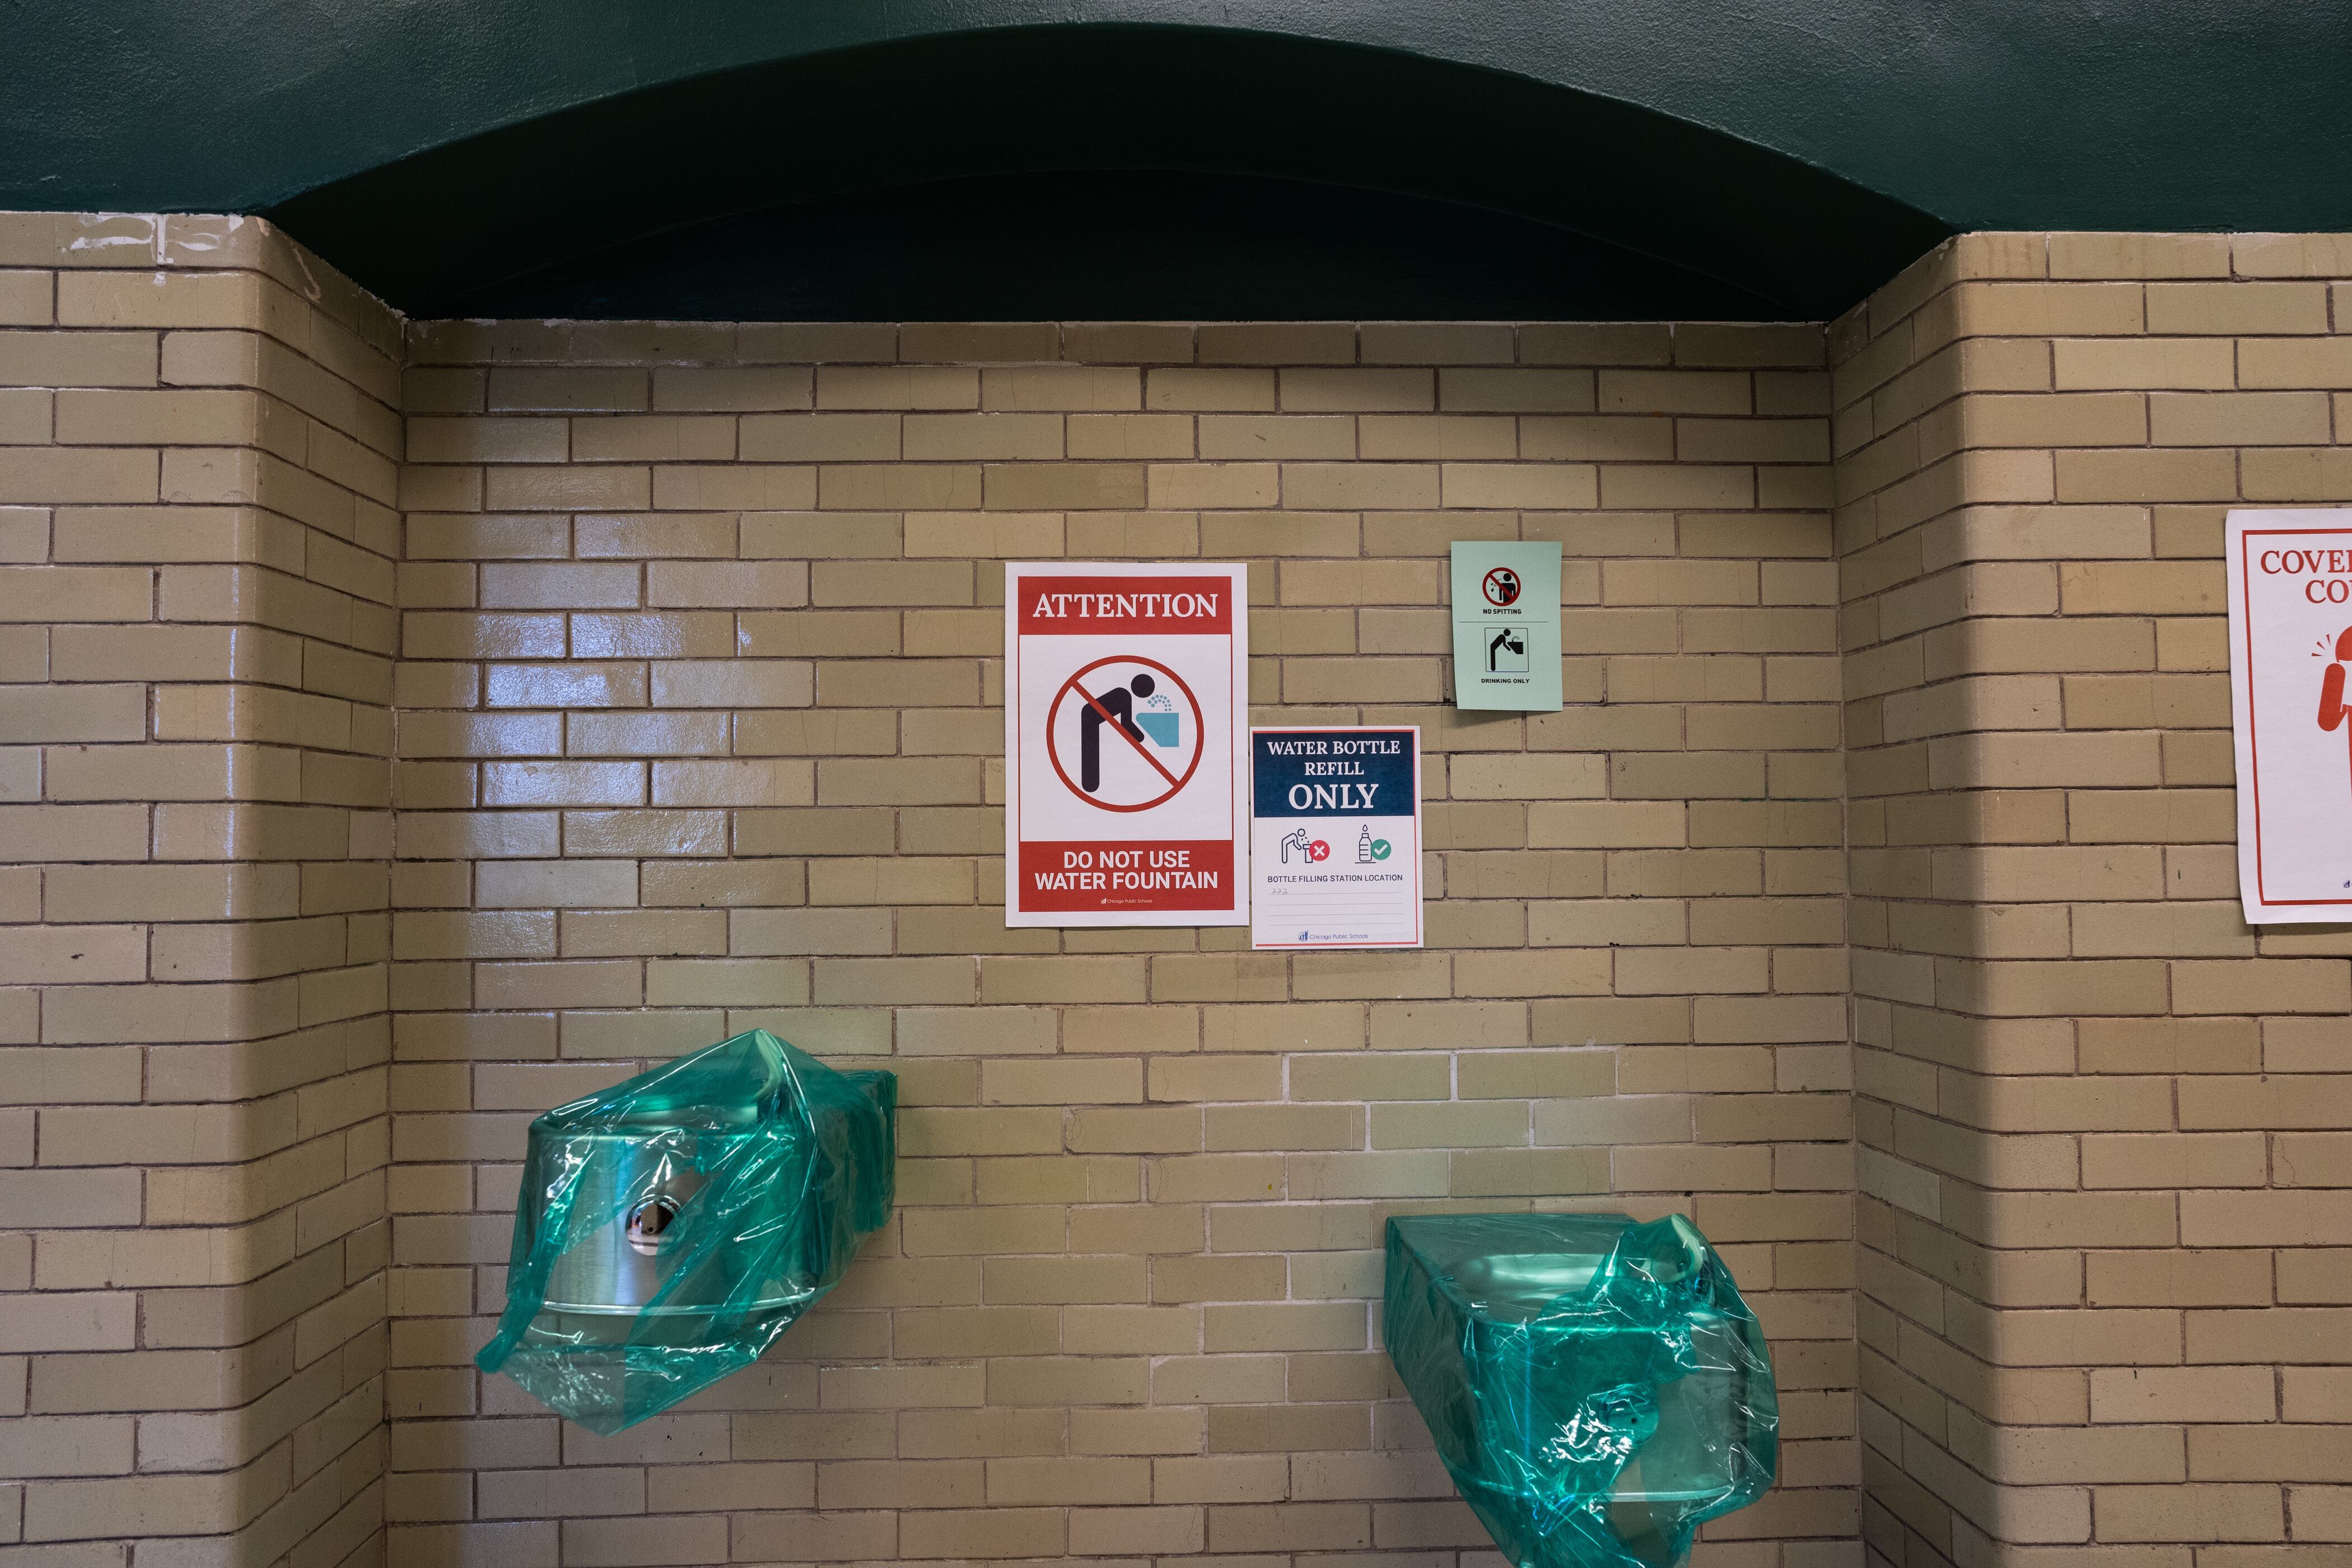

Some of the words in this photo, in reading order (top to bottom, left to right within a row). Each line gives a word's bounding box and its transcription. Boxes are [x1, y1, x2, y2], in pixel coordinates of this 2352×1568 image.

[2306, 580, 2352, 603] CO
[1033, 594, 1218, 617] ATTENTION
[1267, 741, 1328, 755] WATER
[1333, 740, 1400, 754] BOTTLE
[1304, 762, 1364, 776] REFILL
[1289, 783, 1379, 810] ONLY
[1063, 851, 1093, 869] DO
[1099, 850, 1143, 868] NOT
[1149, 850, 1190, 868] USE
[1035, 872, 1106, 890] WATER
[1113, 871, 1218, 889] FOUNTAIN
